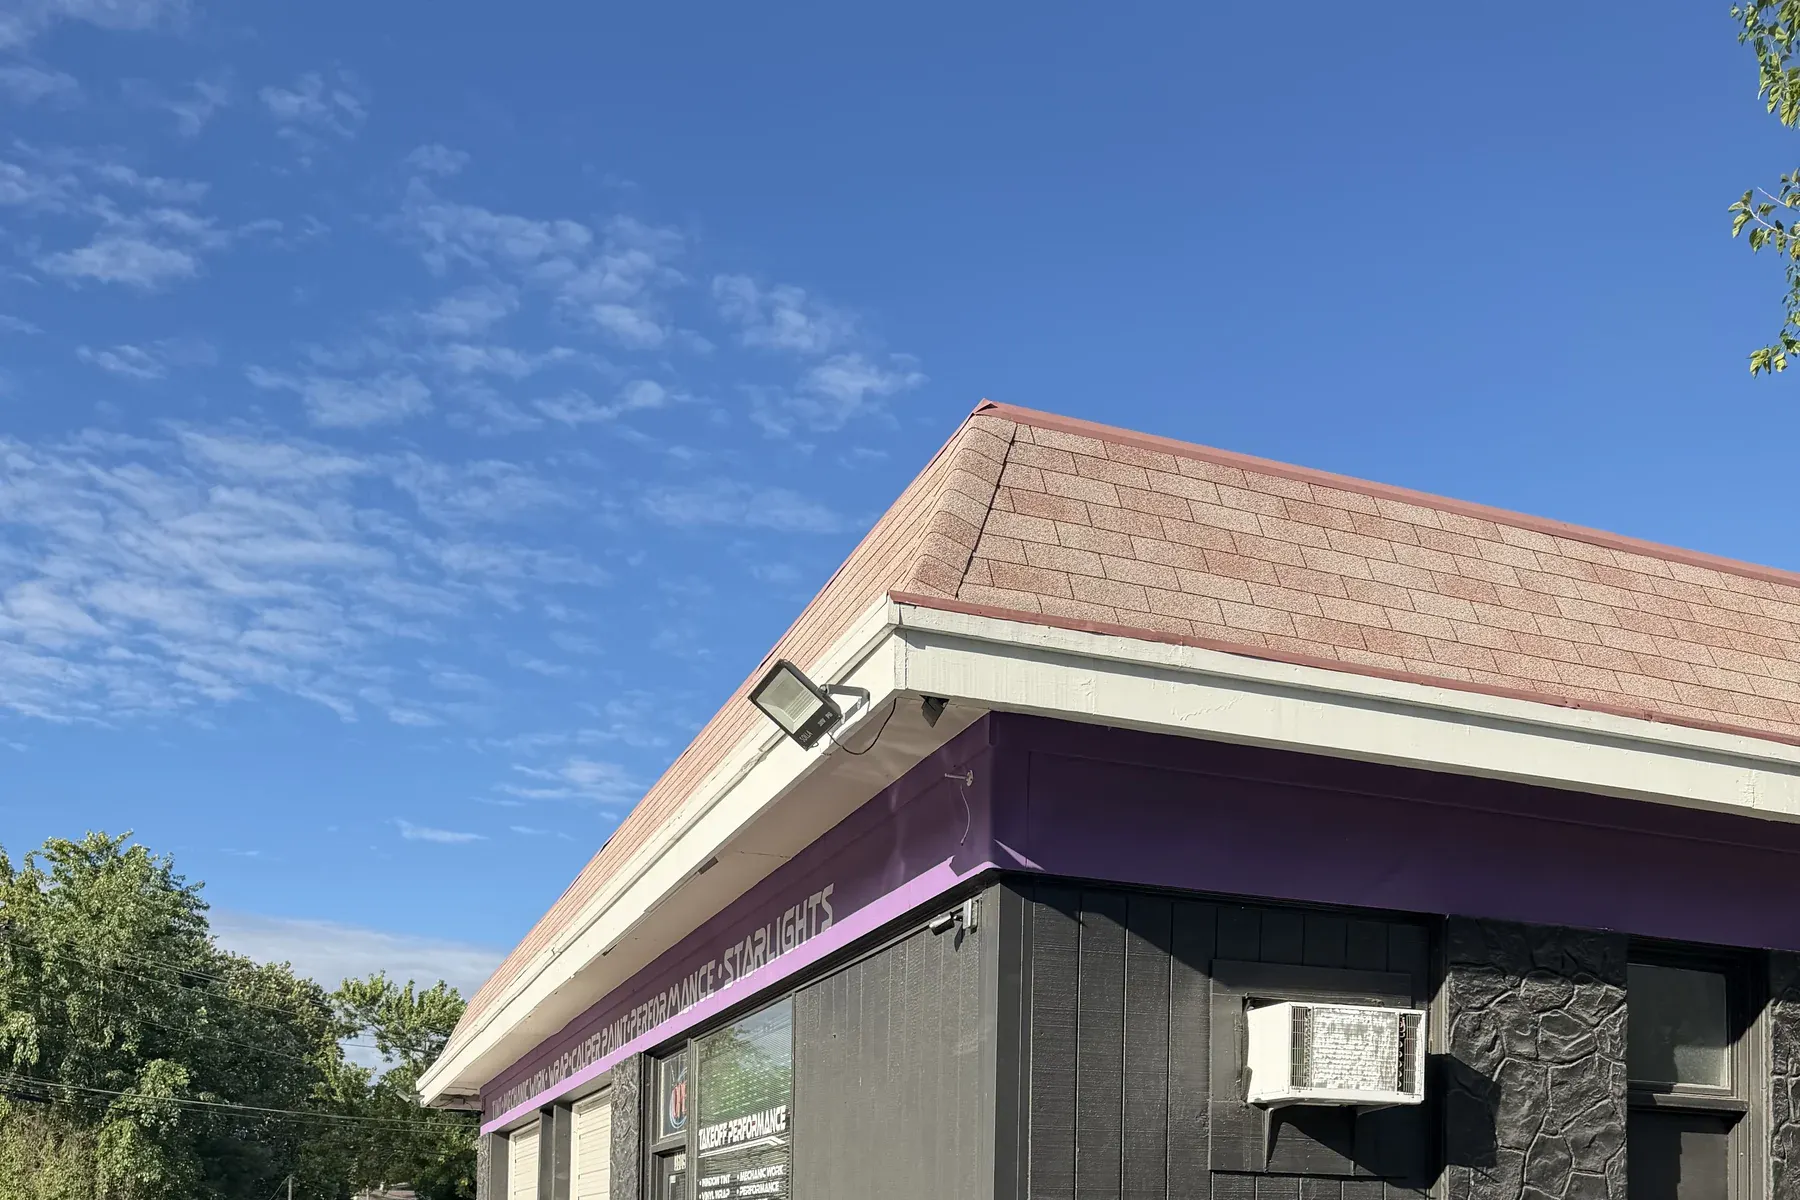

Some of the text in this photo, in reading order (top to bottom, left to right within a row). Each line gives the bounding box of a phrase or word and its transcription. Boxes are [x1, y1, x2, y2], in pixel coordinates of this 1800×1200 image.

[548, 1052, 569, 1087] WRAP
[571, 1033, 601, 1074] CALIPER
[601, 1015, 628, 1058] PAINT
[630, 960, 715, 1038] PERFORMANCE
[723, 883, 834, 990] STARLIGHTS
[698, 1105, 787, 1150] TAKEOFF PERFORMANCE
[739, 1181, 780, 1196] PERFORMANCE
